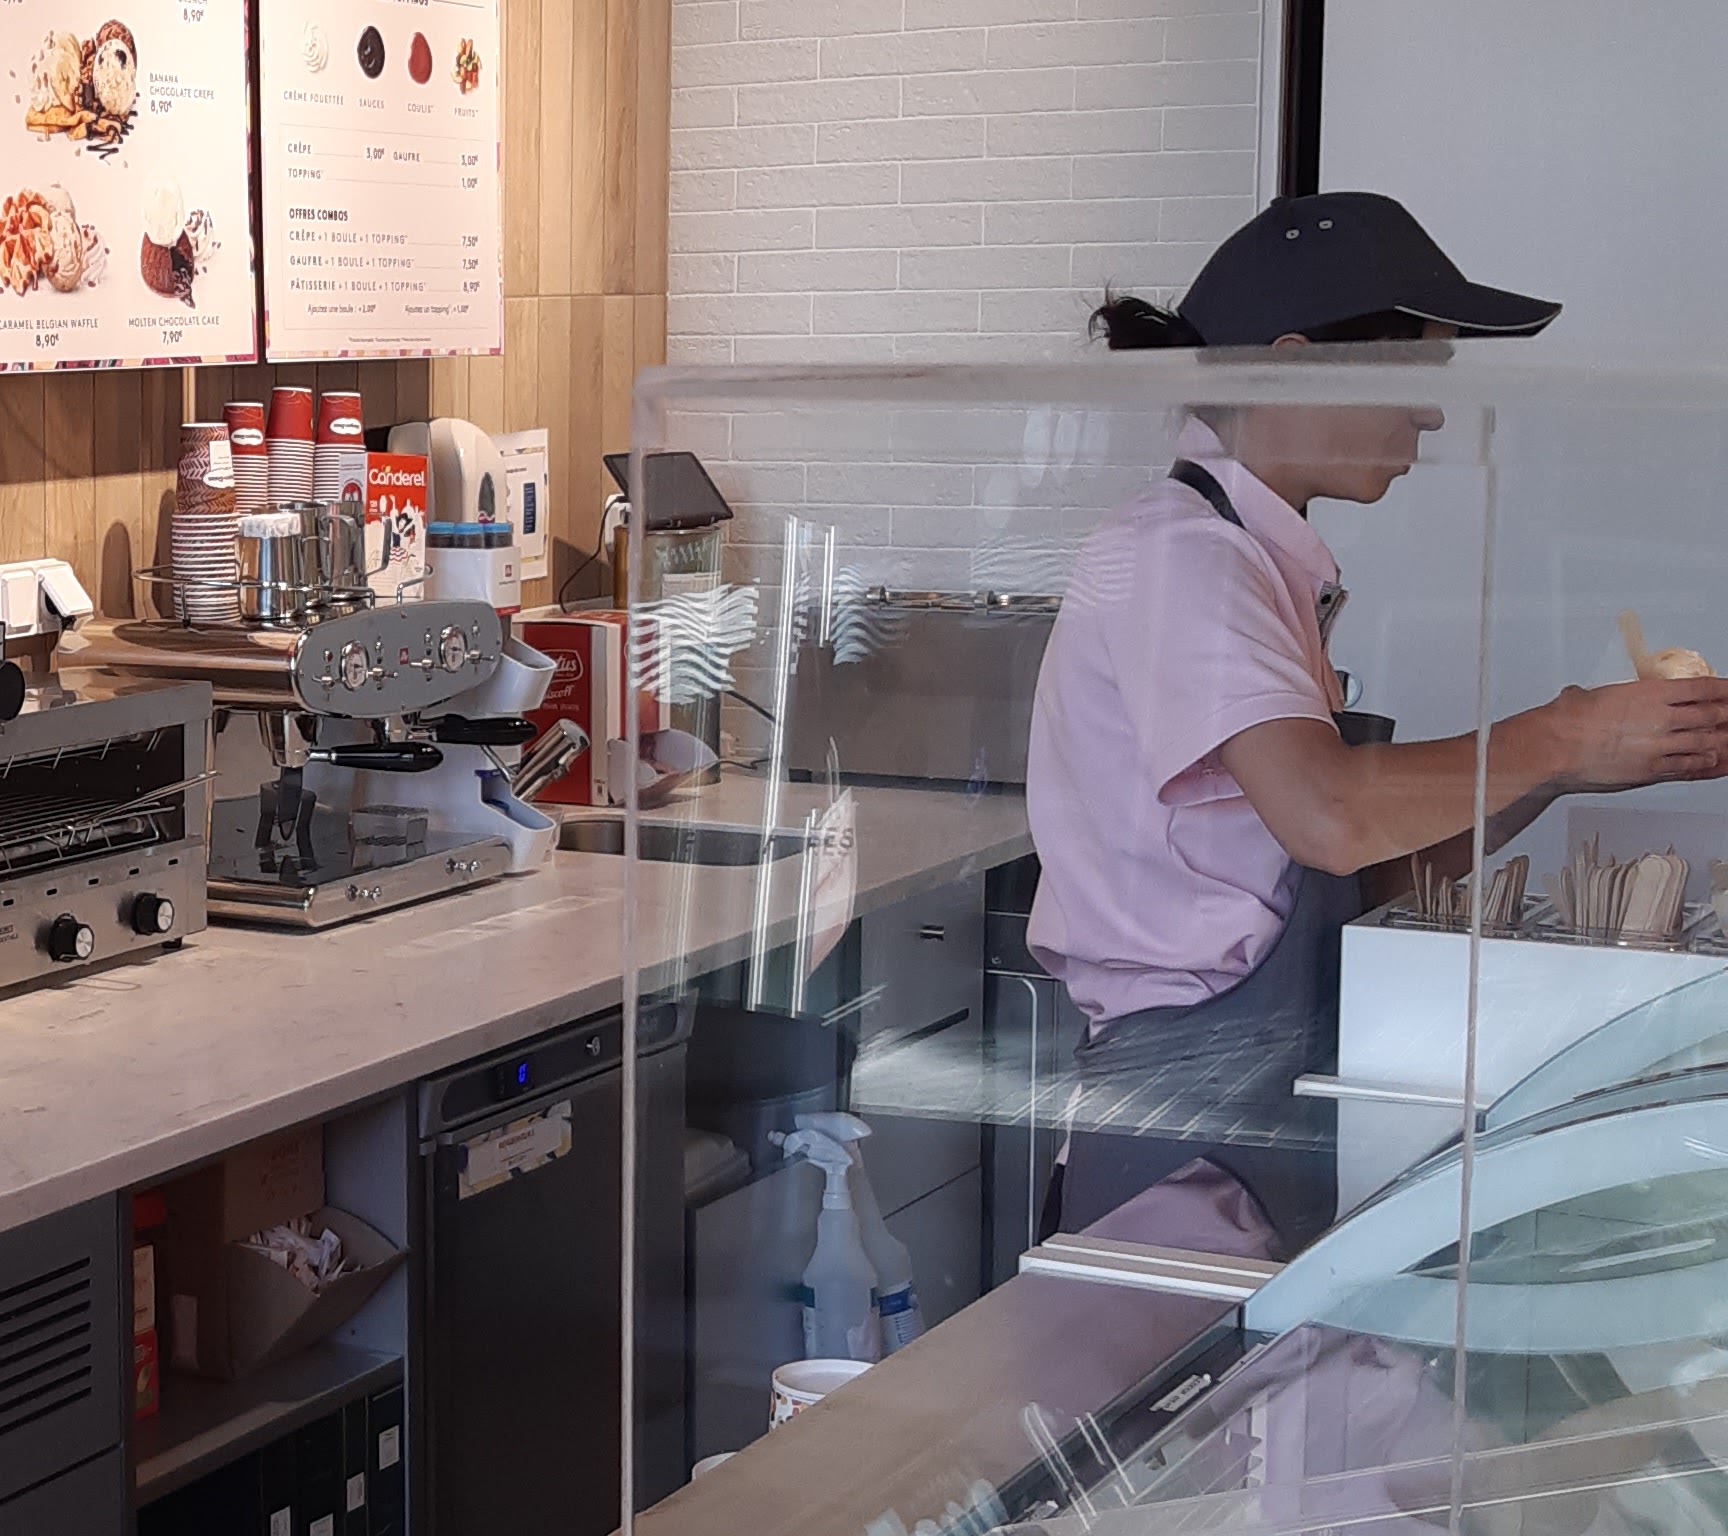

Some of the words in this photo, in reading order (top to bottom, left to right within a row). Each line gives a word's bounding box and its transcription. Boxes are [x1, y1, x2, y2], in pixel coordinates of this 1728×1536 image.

[150, 73, 178, 83] BANANA
[150, 86, 191, 98] CHOCOLATE
[359, 99, 384, 109] SAUCES
[289, 208, 315, 220] OFFRES
[317, 210, 348, 221] COMBOS
[332, 233, 357, 243] BOULE
[290, 256, 322, 266] GAUFRE
[338, 257, 363, 267] BOULE
[351, 282, 376, 290] BOULE
[36, 319, 68, 329] BELGIAN
[71, 319, 98, 329] WAFFLE
[129, 317, 156, 327] MOLTEN
[159, 316, 199, 327] CHOCOLATE
[202, 316, 219, 325] CAKE
[369, 467, 425, 486] Canderel
